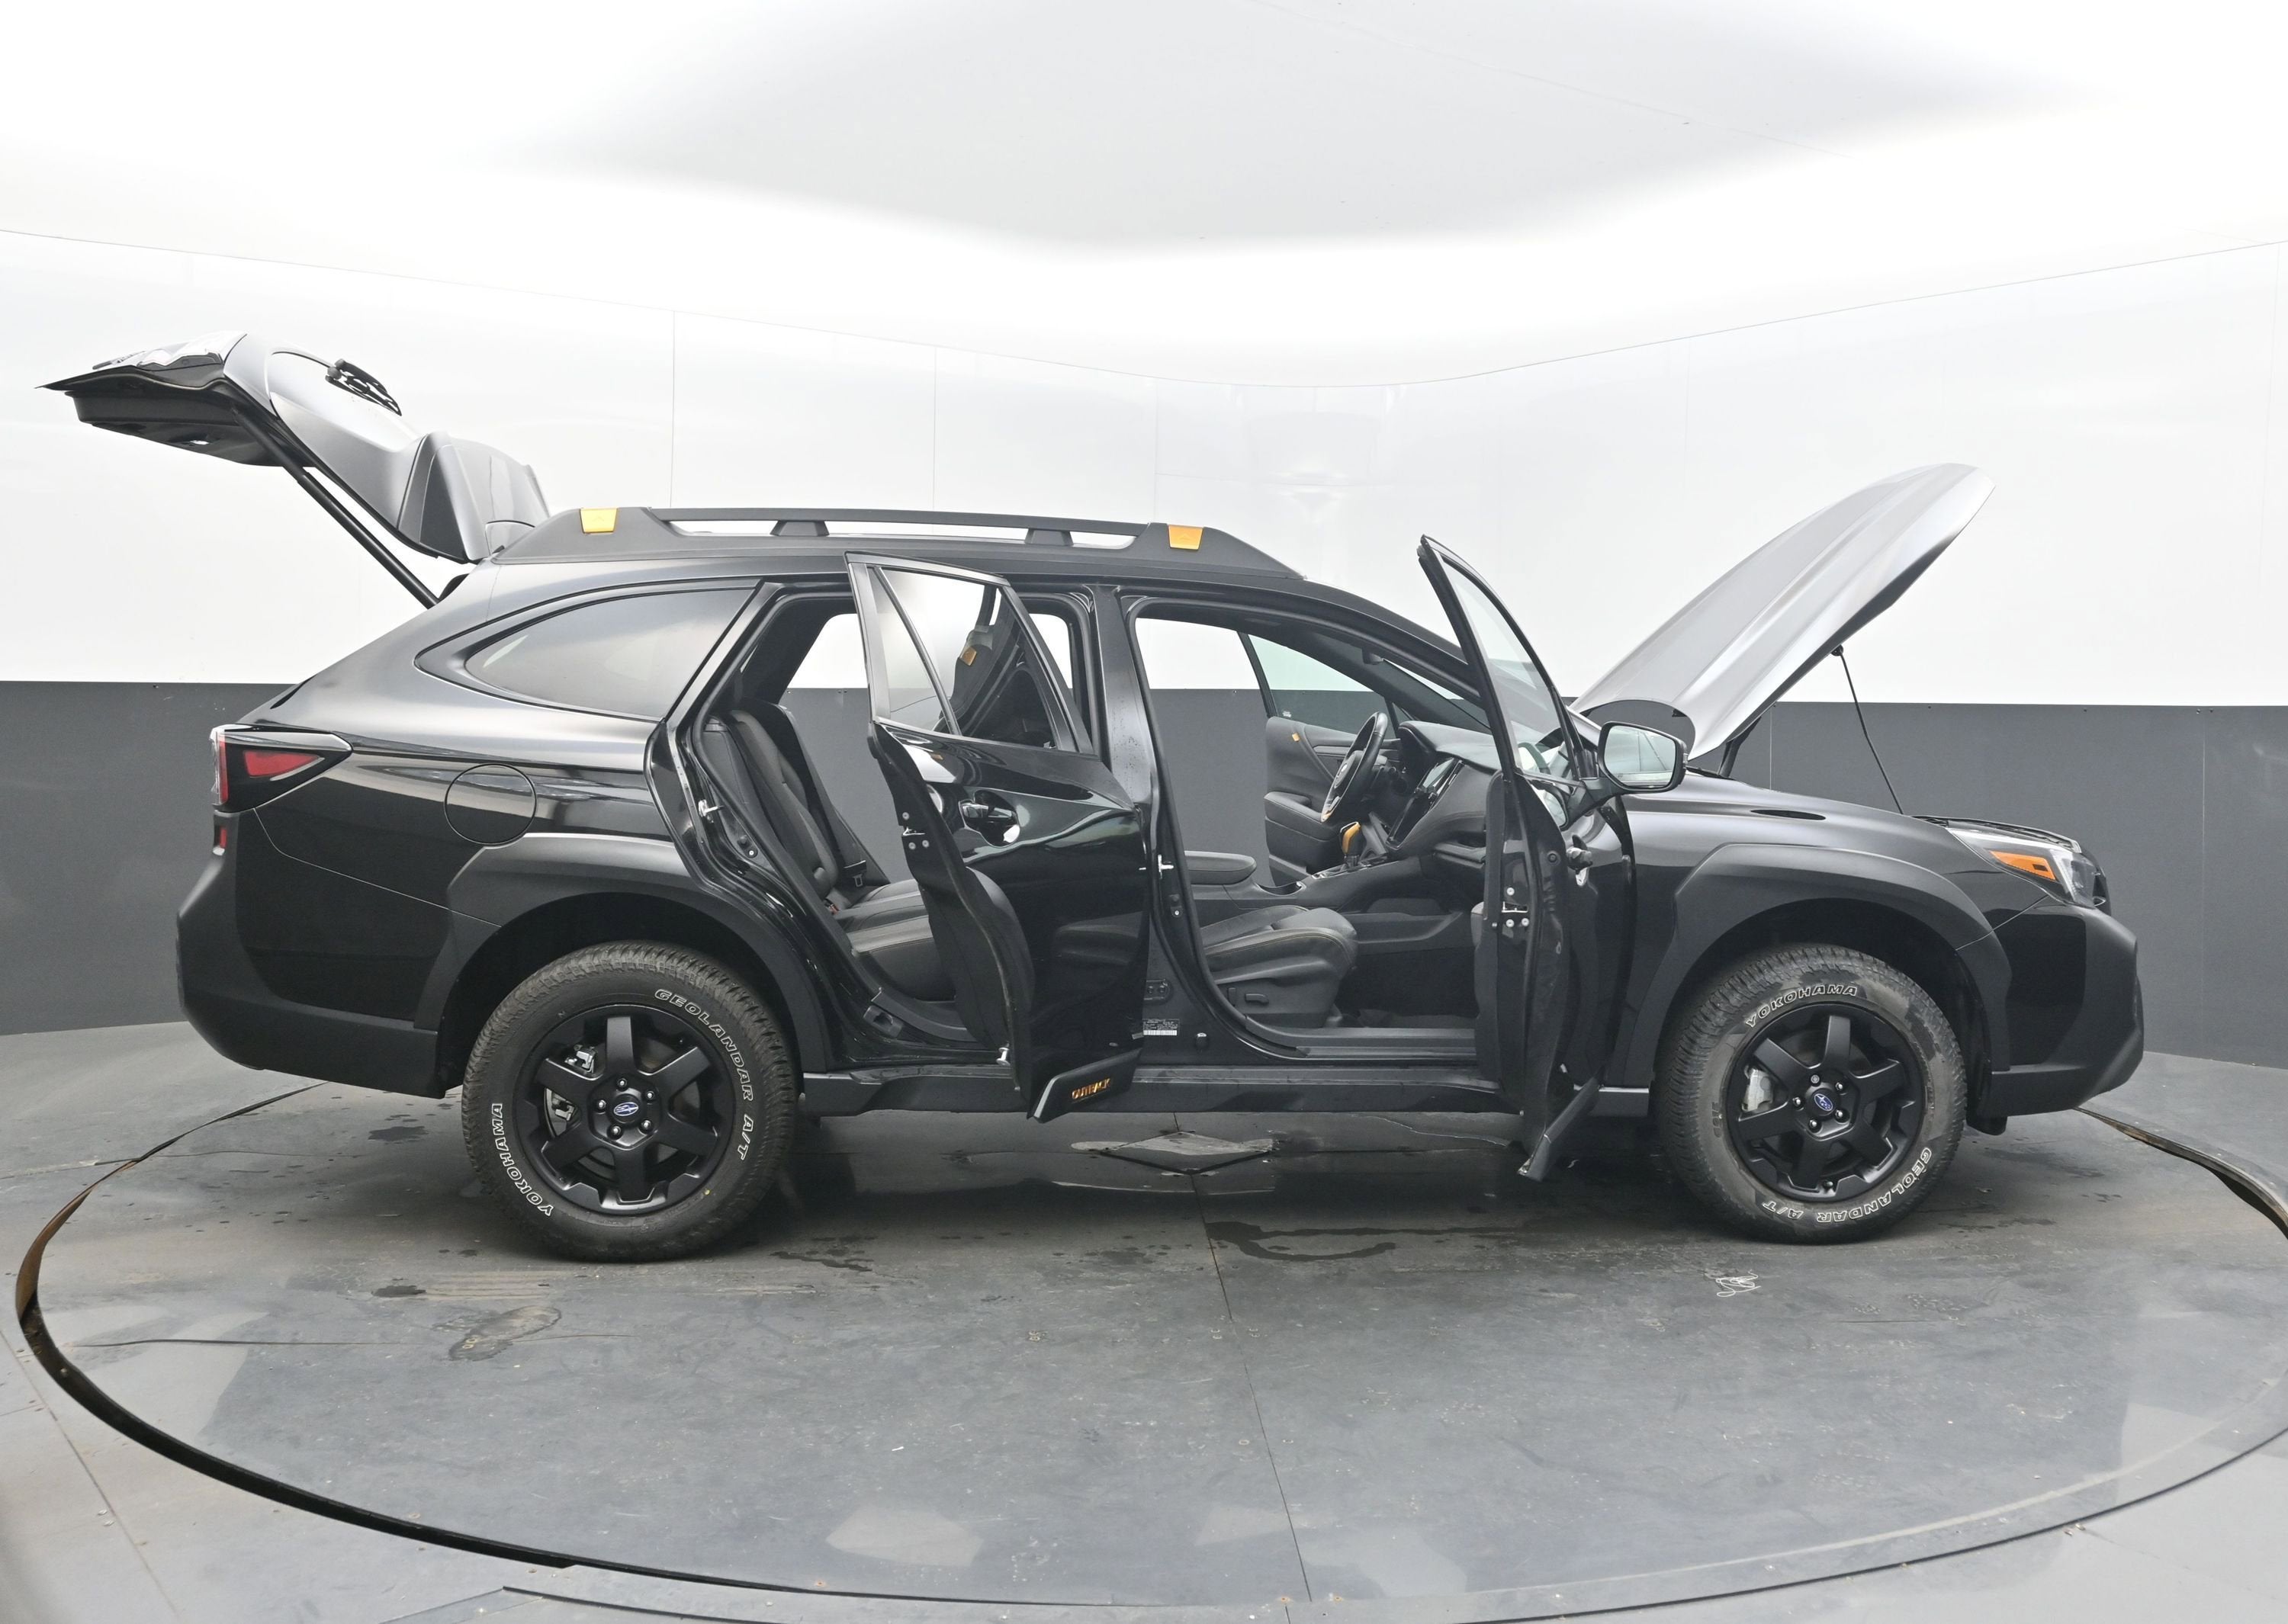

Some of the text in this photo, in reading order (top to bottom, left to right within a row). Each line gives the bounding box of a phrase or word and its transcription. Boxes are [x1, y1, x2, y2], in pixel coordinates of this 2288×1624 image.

[1745, 984, 1858, 1028] YOKOHAMA
[654, 989, 754, 1160] GEOLANDAR A/T
[491, 1102, 554, 1216] YOKOHAMA
[1763, 1147, 1932, 1223] GEOLANDAR A/T
